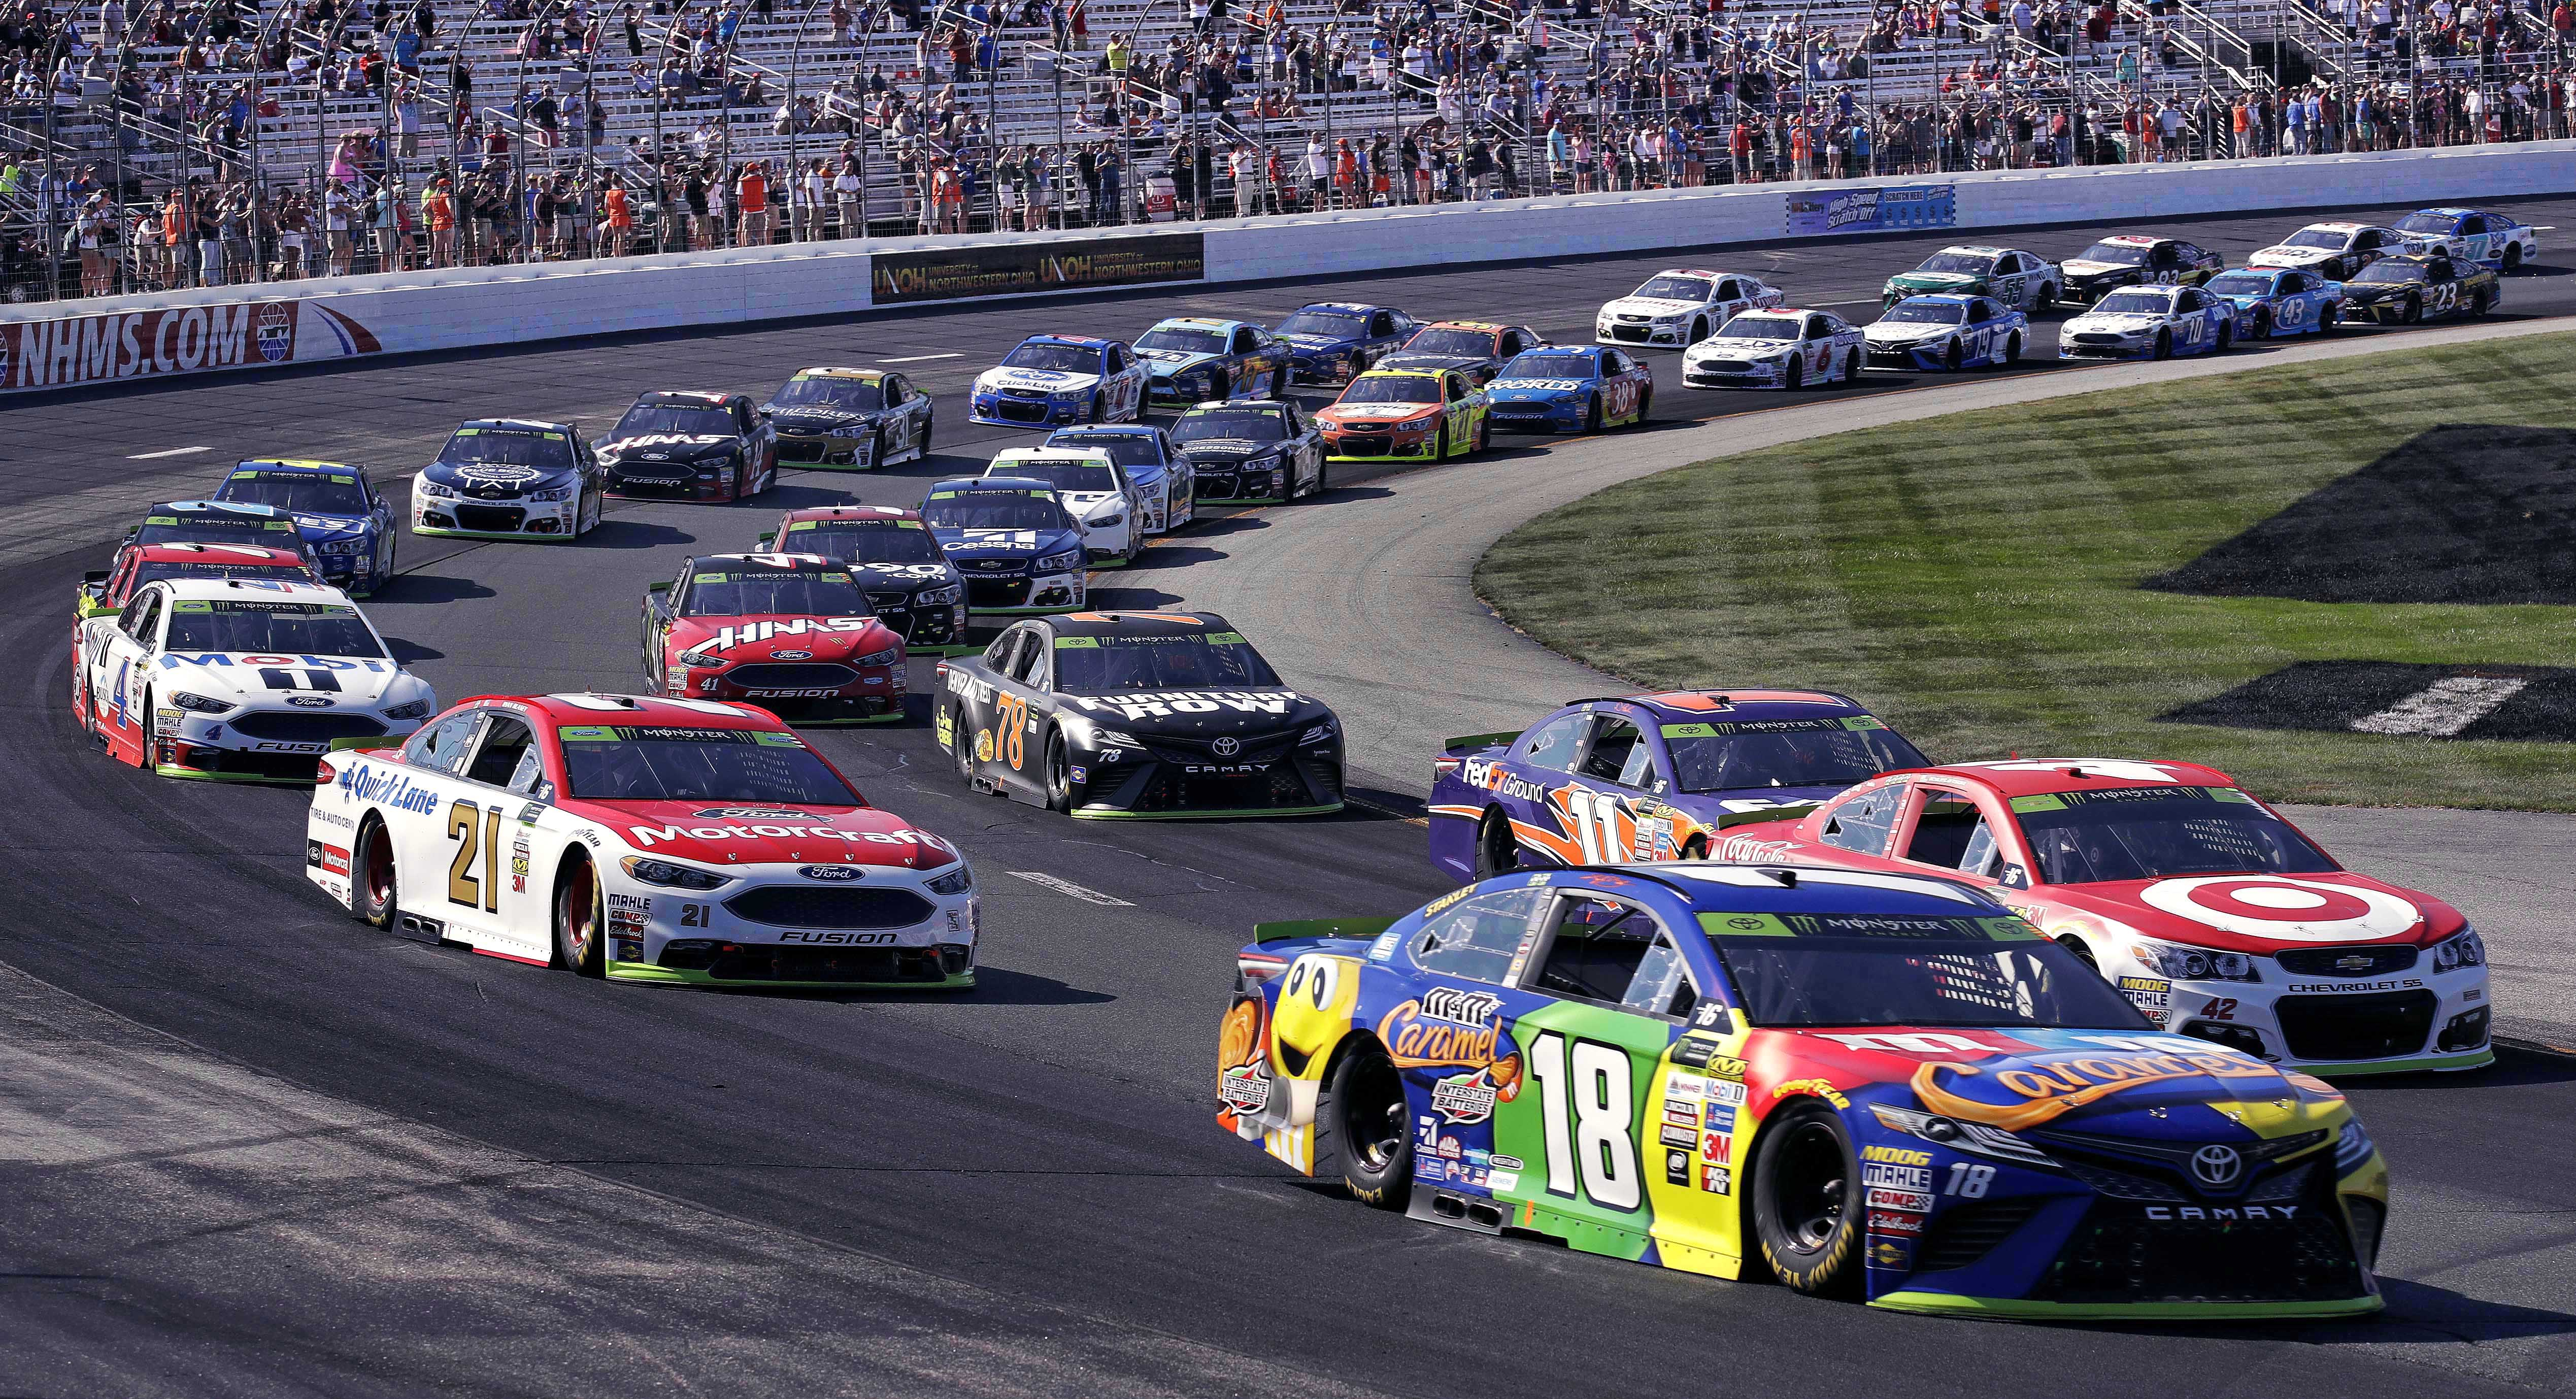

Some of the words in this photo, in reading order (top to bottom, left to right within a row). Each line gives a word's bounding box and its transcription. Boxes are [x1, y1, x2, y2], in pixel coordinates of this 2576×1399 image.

[1830, 199, 1847, 214] High
[1851, 191, 1879, 206] Speed
[1885, 191, 1909, 203] SCRATCH
[1909, 190, 1923, 201] HERE
[1828, 210, 1858, 229] Scratch
[1860, 207, 1877, 220] Off
[1041, 253, 1091, 281] UNOH
[1094, 252, 1135, 263] UNIVERSITY
[929, 264, 971, 275] UNIVERSITY
[1094, 261, 1174, 278] NORTHWESTERN
[1177, 259, 1200, 273] OHIO
[875, 264, 926, 294] UNOH
[929, 273, 1008, 290] NORTHWESTERN
[1011, 272, 1035, 285] OHIO
[2003, 276, 2026, 306] 55
[2437, 282, 2457, 311] 23
[2284, 298, 2305, 325] 43
[2187, 315, 2204, 345] 10
[17, 304, 249, 387] NHMS.COM
[1975, 327, 1991, 358] 19
[1816, 341, 1831, 374] 6
[1013, 369, 1066, 380] Kroger
[997, 380, 1059, 390] ClickList
[1484, 381, 1579, 393] WORLD
[1612, 382, 1628, 415] 38
[622, 478, 681, 486] FUSION
[943, 542, 1035, 551] Cessna
[197, 563, 256, 571] MONSTER
[235, 603, 300, 611] MONSTER
[717, 616, 878, 652] HAAS
[777, 651, 806, 659] Ford
[113, 655, 130, 730] 4
[700, 678, 719, 690] 41
[292, 697, 327, 707] Ford
[745, 690, 839, 698] FUSION
[1077, 691, 1311, 711] FURNITURE
[157, 709, 185, 718] MOOG
[1120, 699, 1287, 722] ROW
[157, 718, 181, 727] MAHLE
[995, 690, 1027, 771] 78
[1741, 719, 1819, 730] MONSTER
[205, 724, 222, 741] 4
[643, 726, 731, 740] MONSTER
[255, 742, 330, 751] FUSI
[1098, 749, 1122, 762] 78
[1186, 765, 1269, 773] CAMRY
[1463, 756, 1510, 792] FedEx
[1503, 773, 1547, 804] Ground
[354, 764, 398, 806] Quick
[398, 776, 438, 816] Lane
[2090, 787, 2179, 800] MONSTER
[311, 807, 322, 820] TIRE
[322, 811, 326, 822] &
[327, 812, 342, 826] AUTO
[1567, 787, 1622, 865] 11
[629, 822, 947, 852] Motorcraft
[447, 798, 504, 914] 21
[811, 866, 852, 880] Ford
[512, 874, 526, 894] 3M
[608, 893, 651, 910] MAHLE
[1424, 882, 1479, 917] STANLEY
[611, 910, 640, 921] COMP
[680, 904, 711, 928] 21
[1826, 917, 1949, 930] MONSTER
[609, 925, 643, 939] Edelbrock
[780, 932, 898, 944] FUSION
[2121, 977, 2170, 991] MOOG
[2288, 981, 2397, 993] CHEVROLET
[2403, 979, 2423, 989] SS
[2200, 997, 2238, 1020] 42
[1377, 1000, 1502, 1064] Caramel
[1223, 1077, 1268, 1094] INTERSTATE
[1439, 1082, 1495, 1104] INTERSTATE
[1705, 1079, 1733, 1097] Mobil
[1772, 1077, 1852, 1111] GOODYEAR
[1911, 1047, 2281, 1131] Caramel
[1225, 1087, 1264, 1105] BATTERIES
[1437, 1094, 1488, 1116] BATTERIES
[1530, 1027, 1642, 1214] 18
[1704, 1133, 1731, 1164] 3M
[1859, 1146, 1934, 1167] MOOG
[1866, 1164, 1931, 1188] MAHLE
[1943, 1162, 1997, 1198] 18
[1870, 1190, 1917, 1206] COMP
[2146, 1206, 2299, 1220] CAMRY
[1868, 1214, 1924, 1233] Edelbrock
